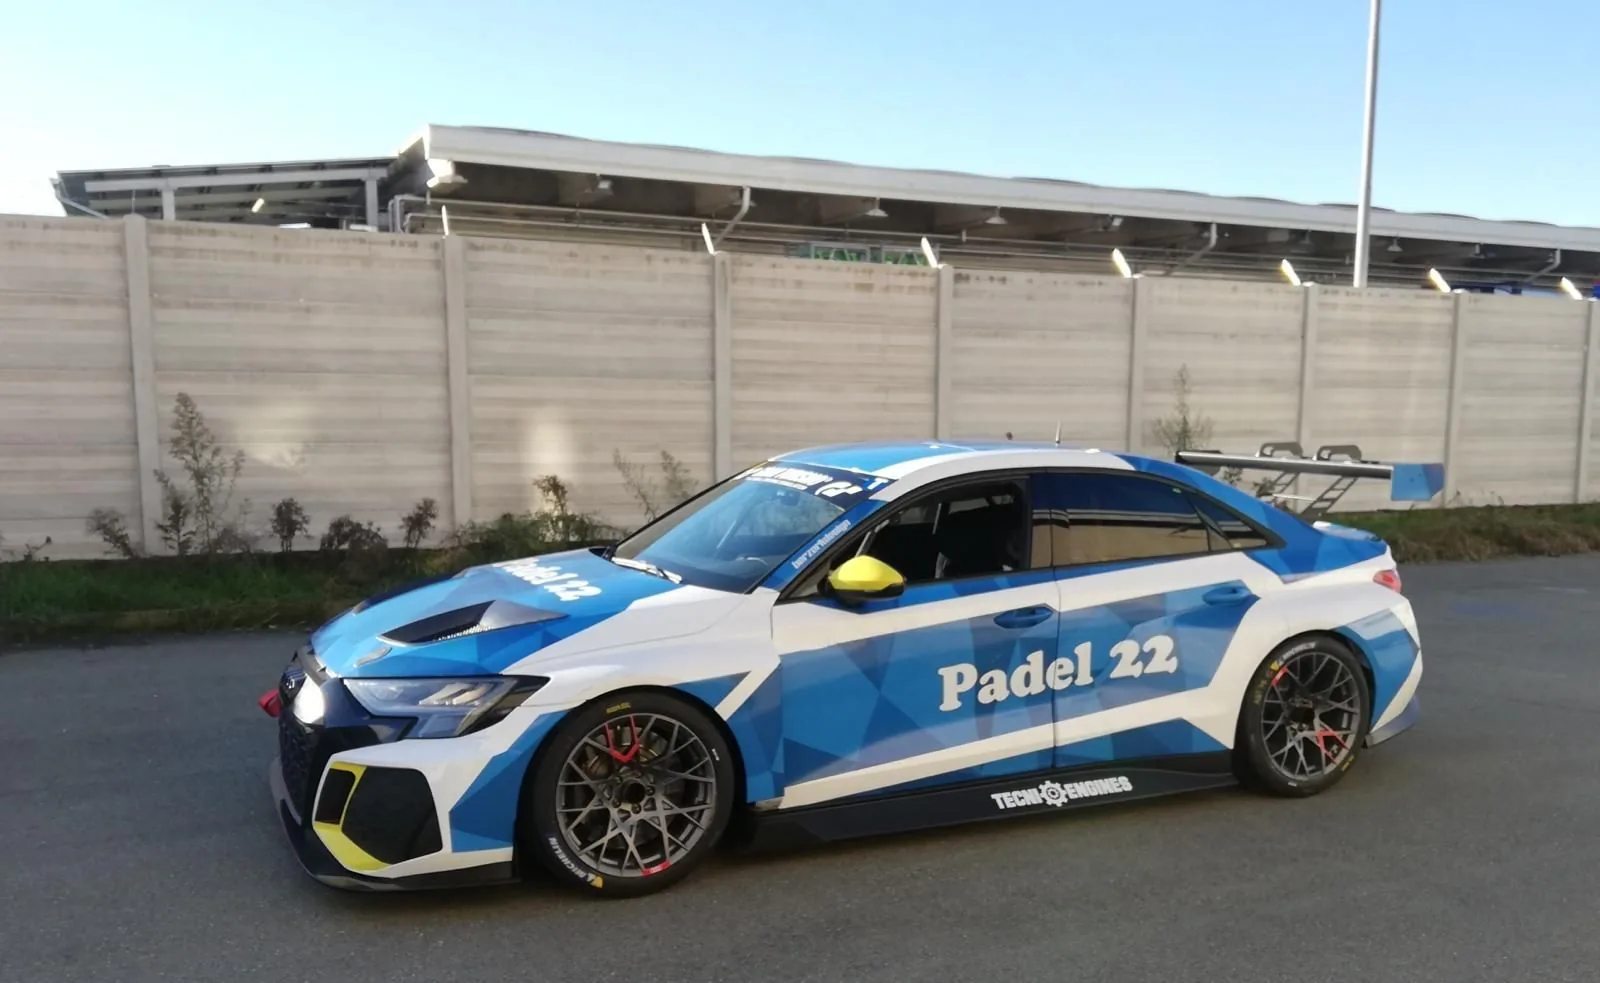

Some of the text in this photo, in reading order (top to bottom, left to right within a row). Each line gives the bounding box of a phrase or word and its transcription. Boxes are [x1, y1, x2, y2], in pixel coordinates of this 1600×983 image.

[937, 635, 1178, 711] Padel 22
[990, 776, 1133, 809] TECNI ENGINES
[548, 837, 587, 878] MICHELIN
